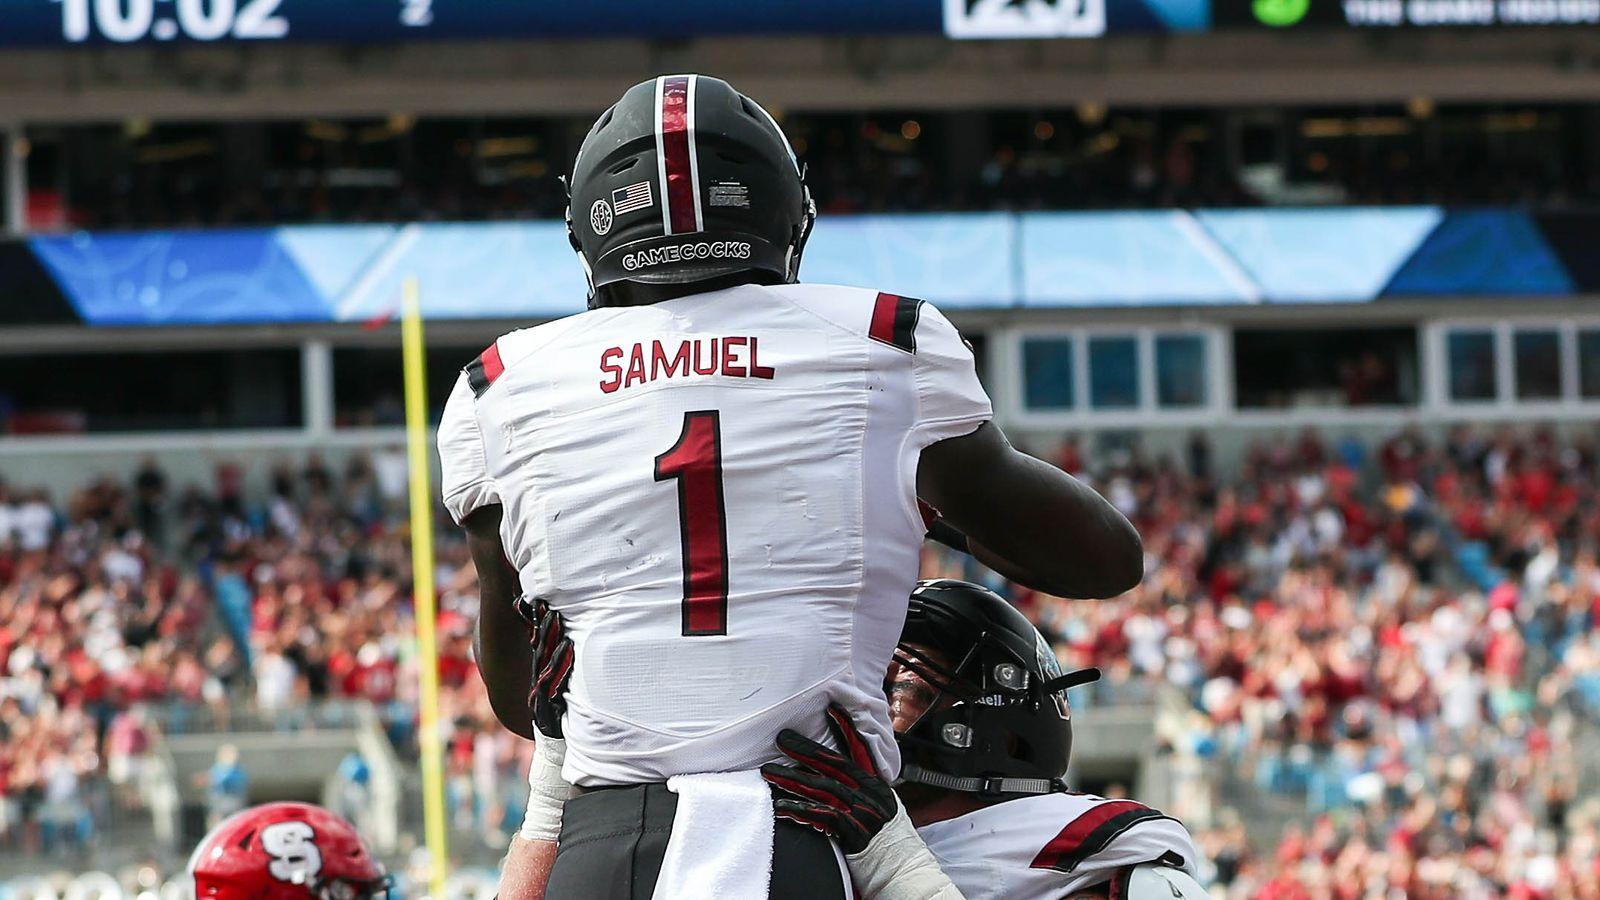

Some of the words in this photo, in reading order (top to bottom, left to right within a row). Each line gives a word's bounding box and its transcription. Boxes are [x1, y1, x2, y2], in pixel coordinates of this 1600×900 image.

[622, 241, 751, 271] GAMECOCKS
[599, 336, 776, 394] SAMUEL
[653, 409, 729, 637] 1
